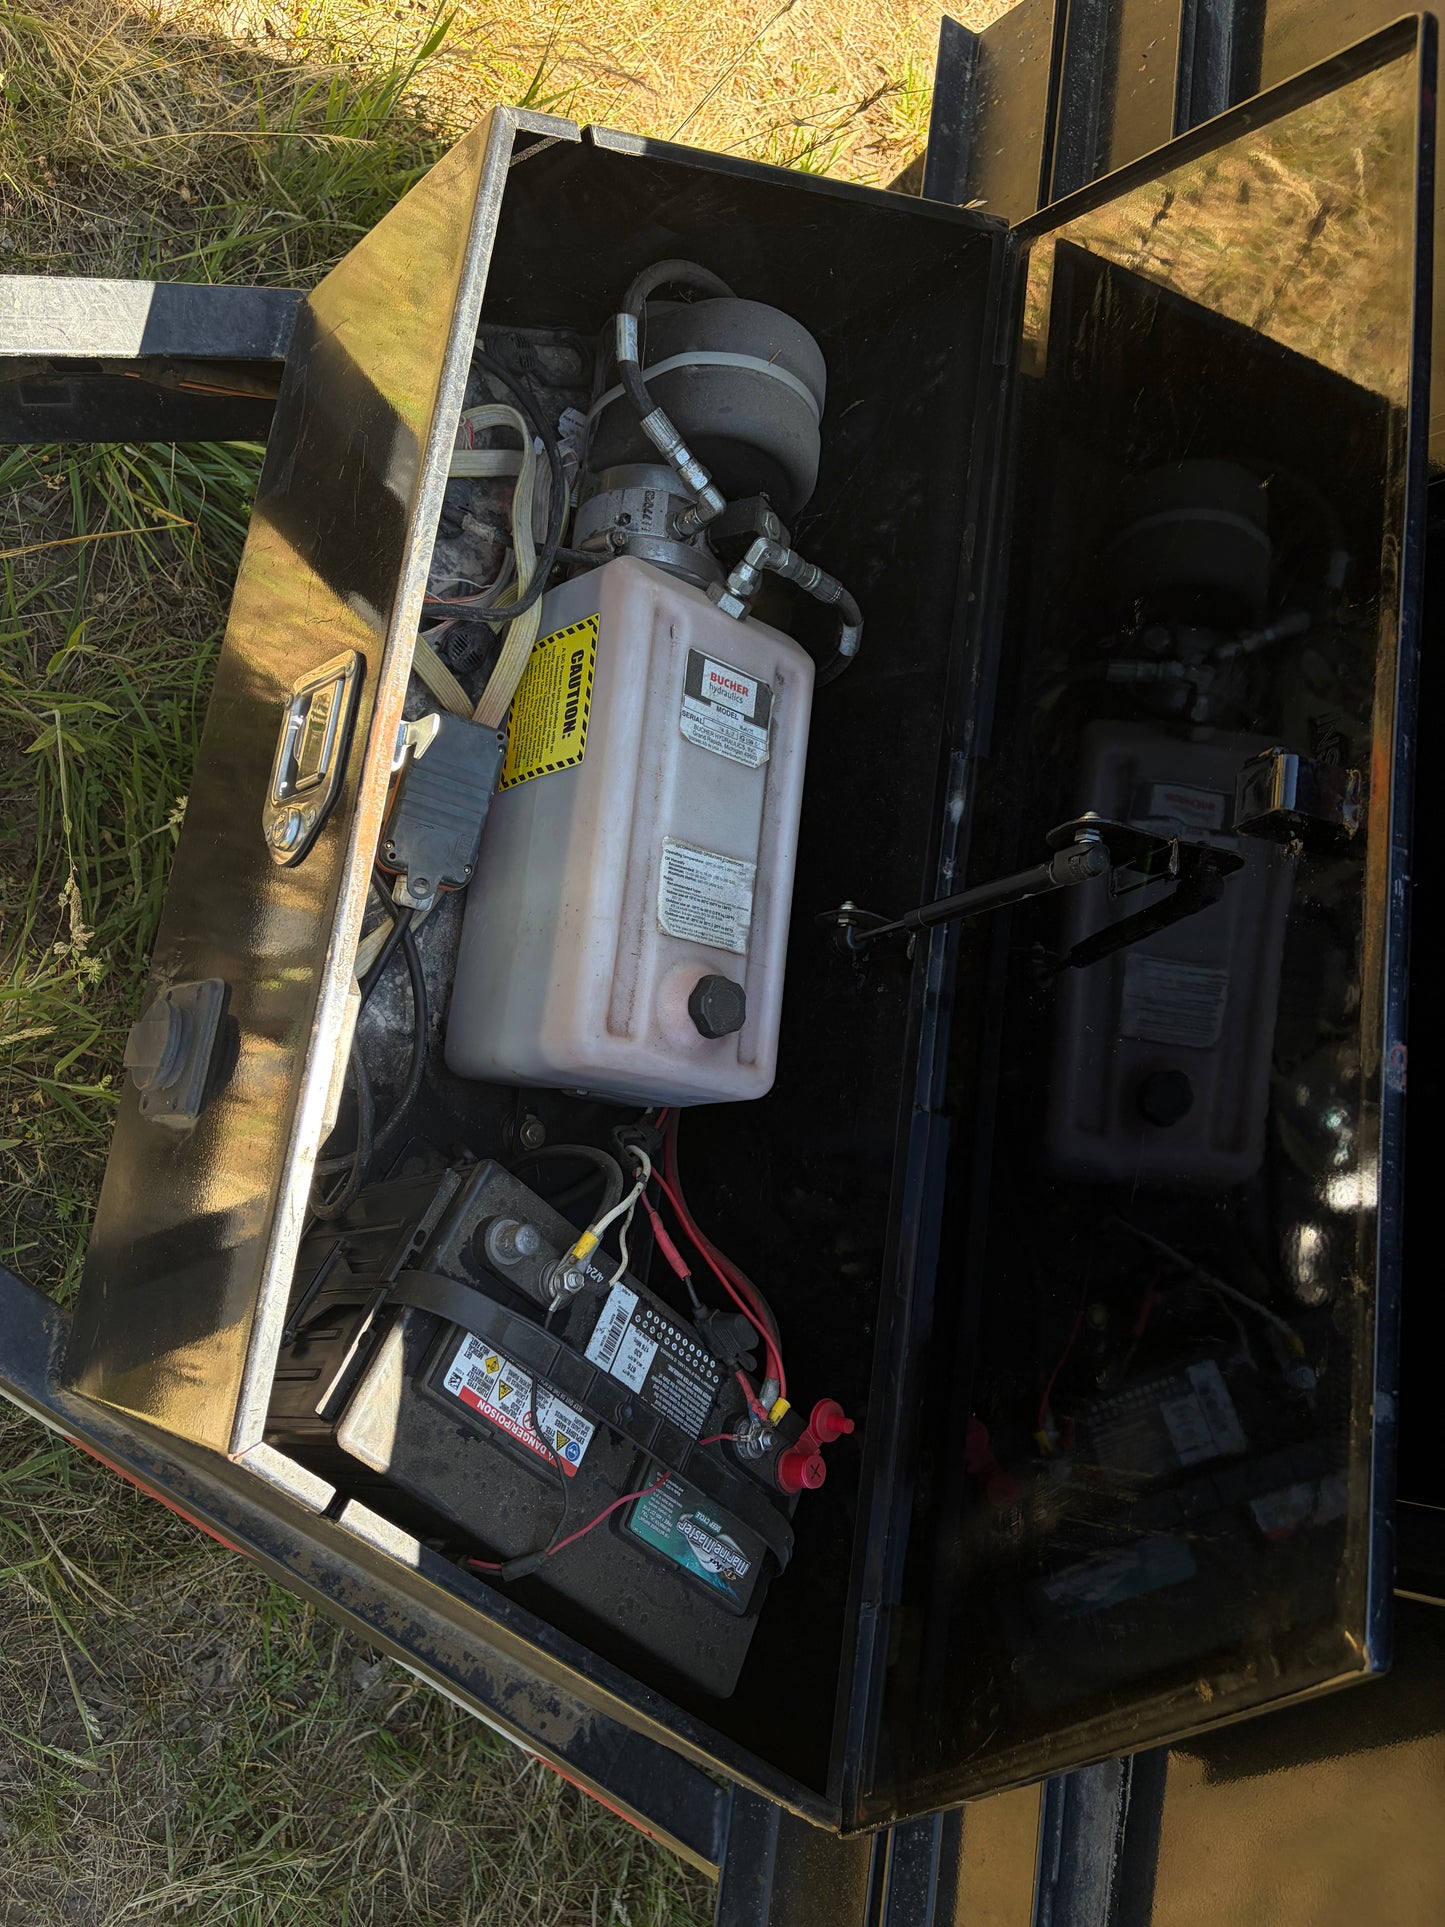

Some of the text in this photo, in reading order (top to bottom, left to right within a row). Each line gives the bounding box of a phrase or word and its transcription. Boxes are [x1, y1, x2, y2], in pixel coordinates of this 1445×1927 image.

[709, 671, 749, 697] BUCHER
[560, 647, 585, 740] CAUTION:
[708, 681, 743, 705] hydraulics
[681, 709, 702, 724] SERIAL
[715, 704, 739, 720] MODEL
[693, 722, 714, 738] BUCHER
[586, 1264, 604, 1283] 4/24
[463, 1349, 473, 1360] GET
[465, 1343, 484, 1360] MEDICAL
[478, 1343, 490, 1356] HELP
[640, 1343, 649, 1353] 175
[626, 1361, 637, 1374] 675
[465, 1377, 489, 1398] FLUSH EYES
[466, 1369, 491, 1391] IMMEDIATELY
[483, 1373, 495, 1385] WITH
[476, 1398, 547, 1454] DANGER/POISON
[543, 1424, 556, 1437] EYES.
[553, 1418, 585, 1445] EXPLOSIVE GASES
[694, 1510, 721, 1533] DEEP CYCLE
